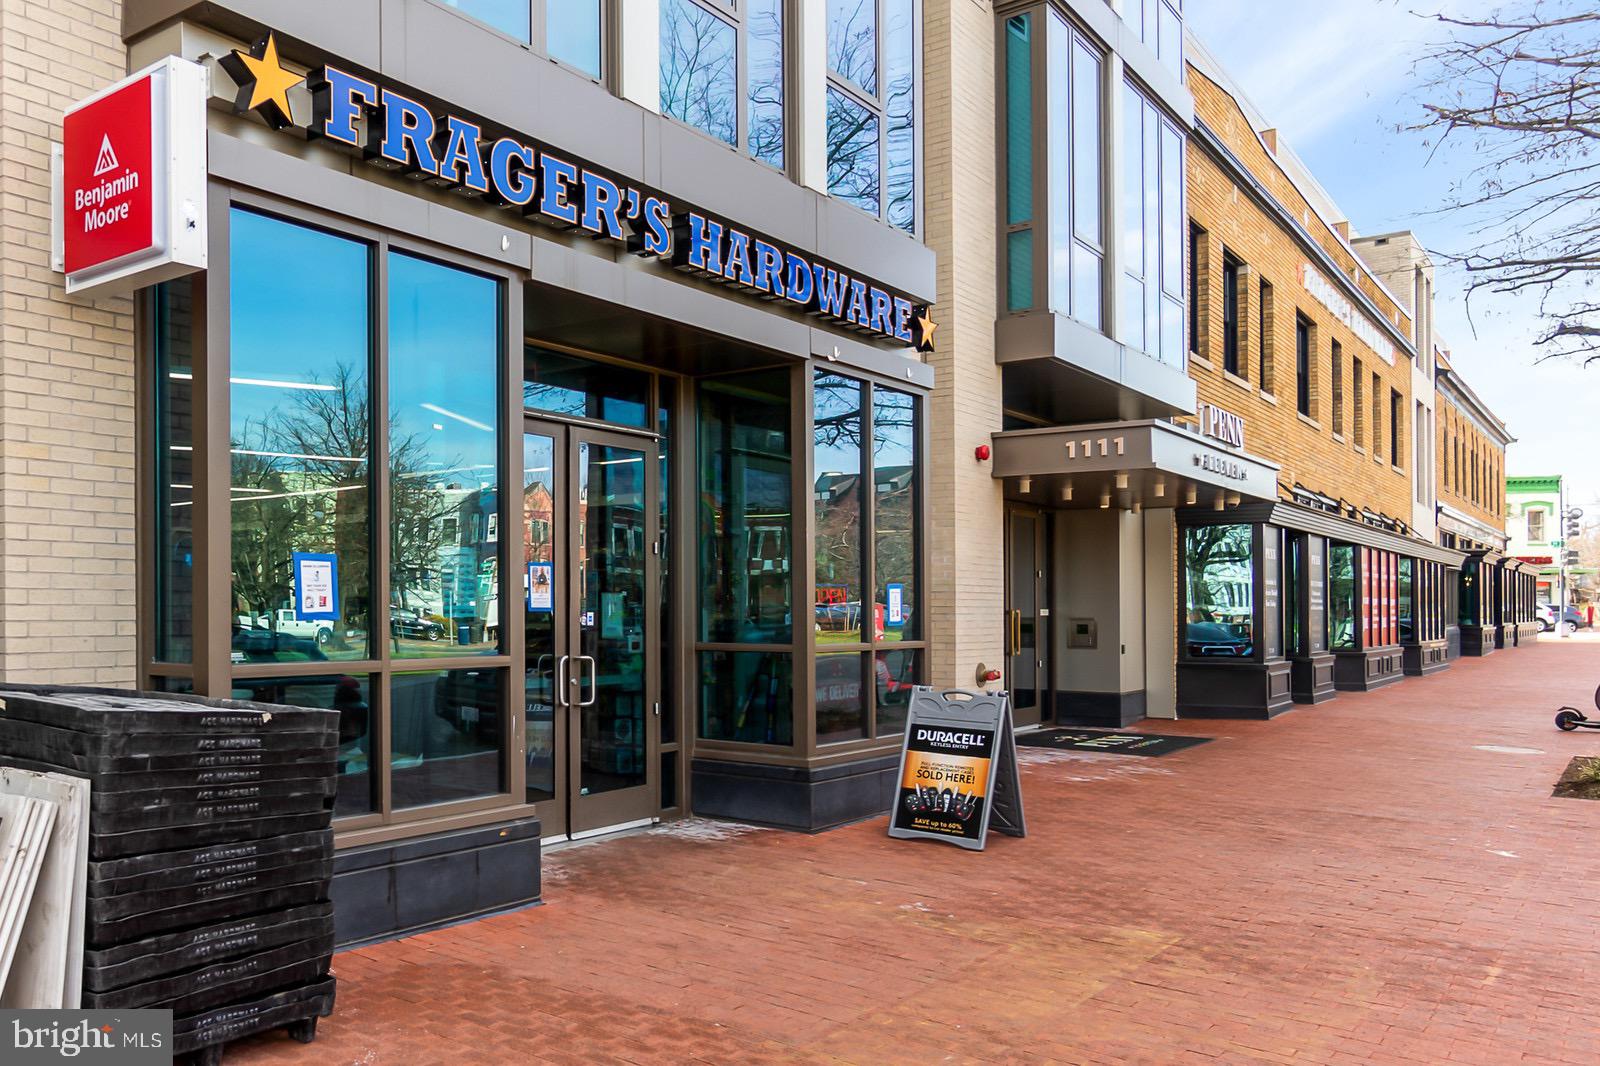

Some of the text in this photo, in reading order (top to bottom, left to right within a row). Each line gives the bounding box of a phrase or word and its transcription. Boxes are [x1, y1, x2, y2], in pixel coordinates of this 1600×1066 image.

[75, 168, 139, 211] Benjamin
[324, 64, 913, 343] FRAGER'S HARDWARE
[84, 202, 129, 233] Moore
[1065, 436, 1124, 459] 1111
[917, 729, 984, 746] DURACELL
[916, 769, 976, 785] SOLD HERE!
[914, 817, 930, 825] SAVE
